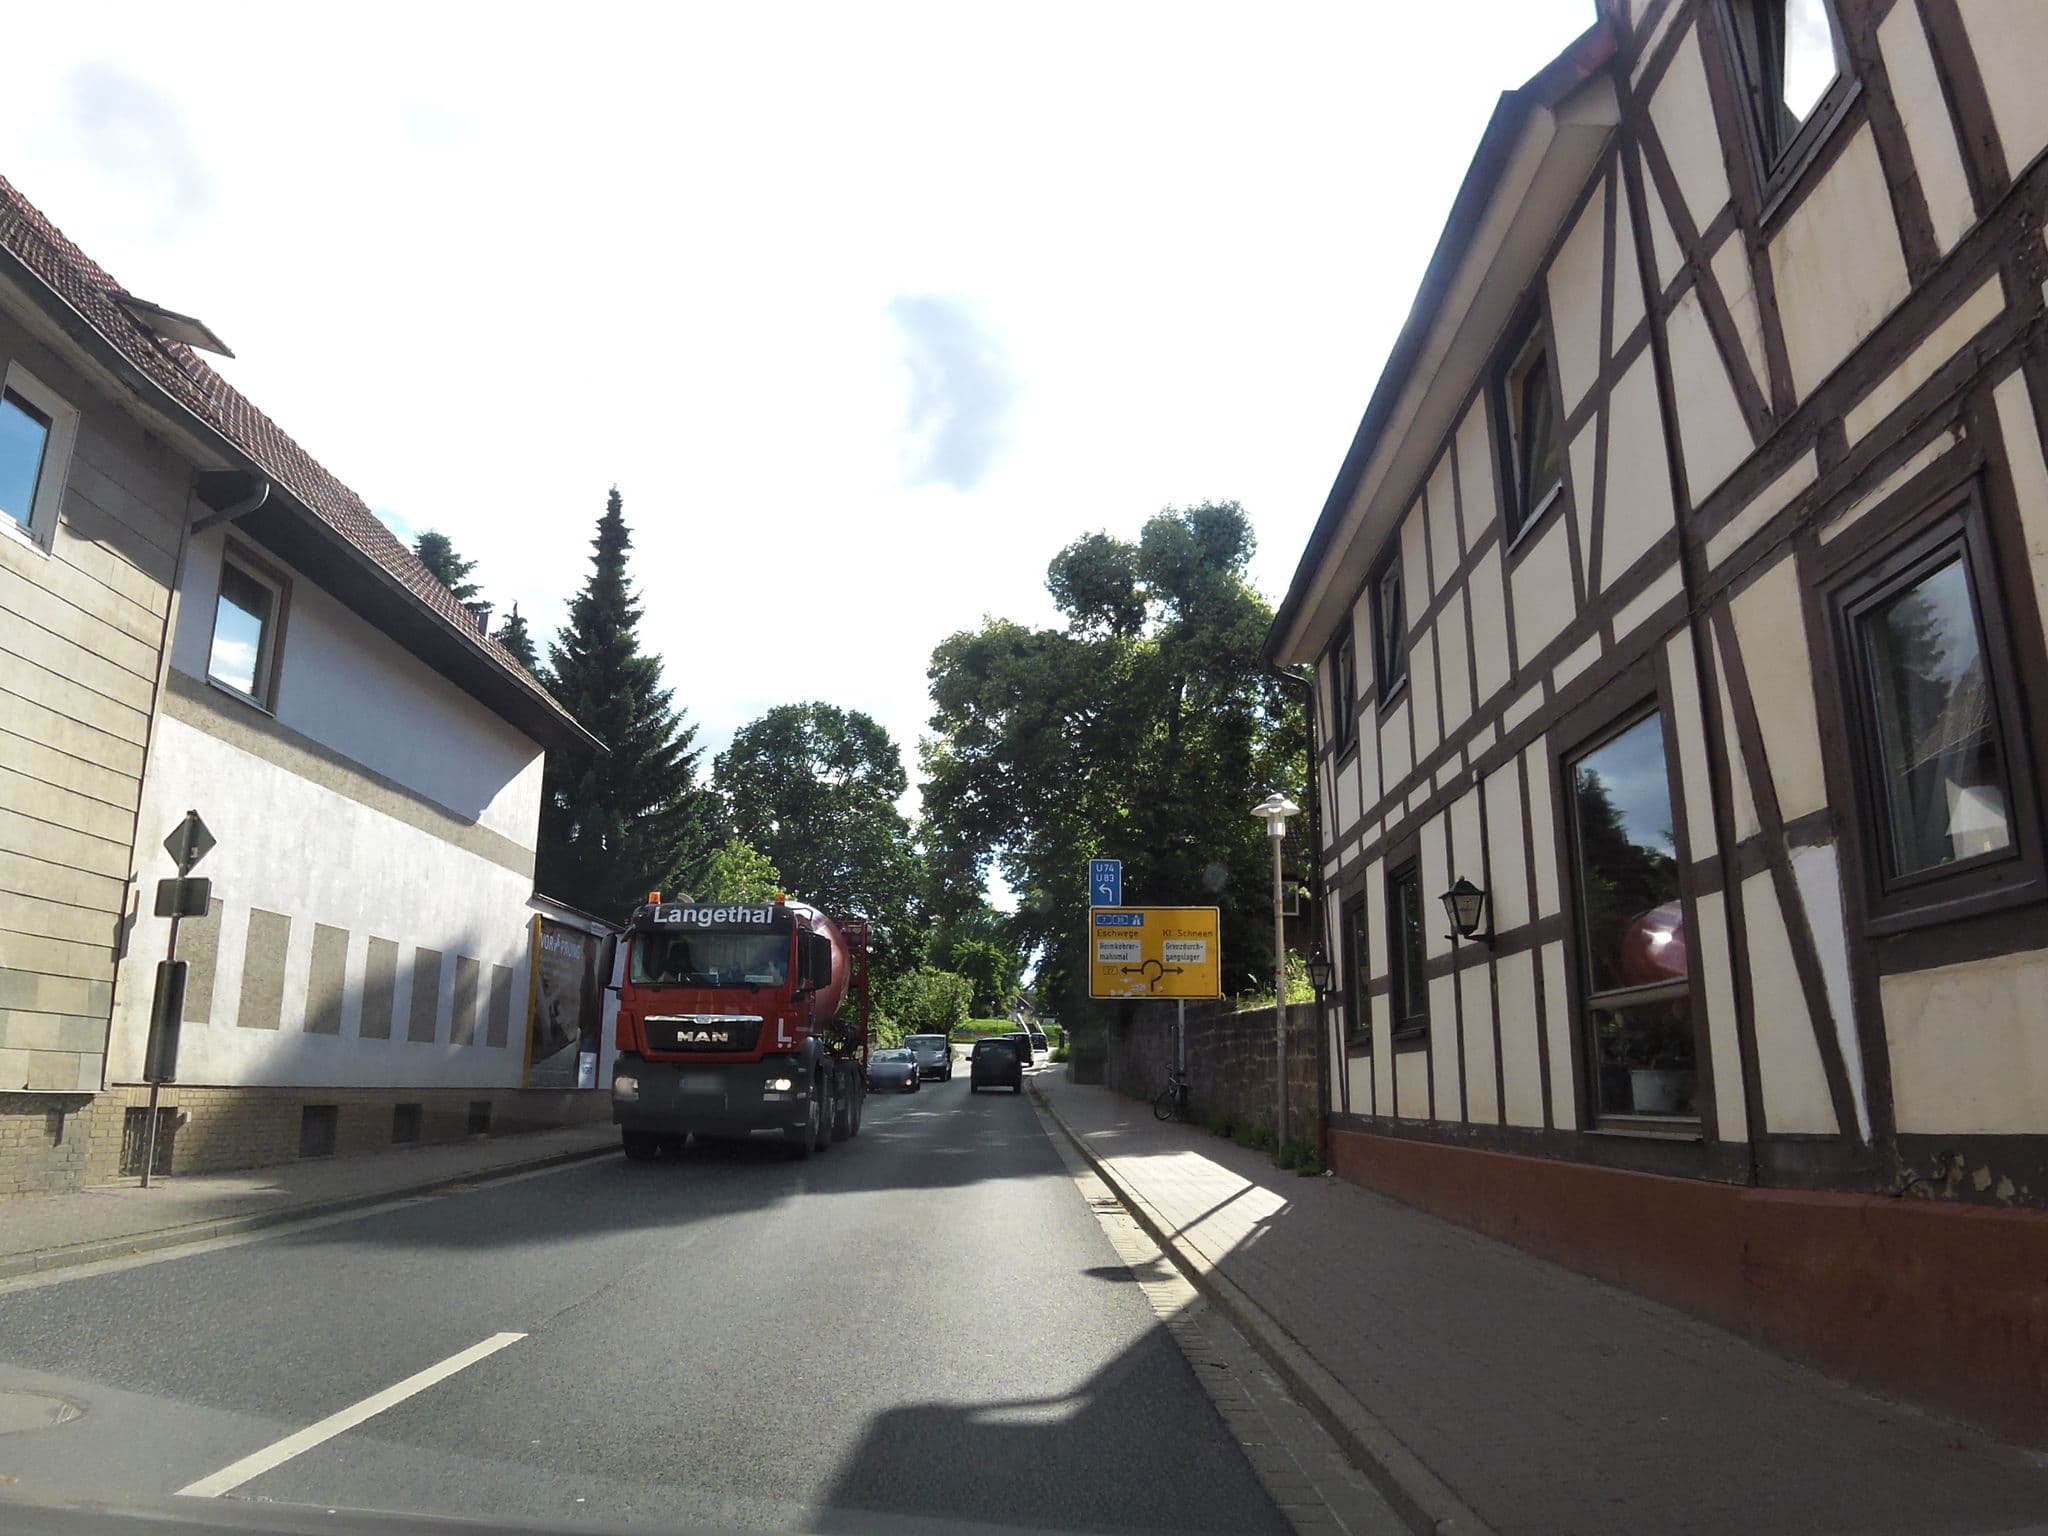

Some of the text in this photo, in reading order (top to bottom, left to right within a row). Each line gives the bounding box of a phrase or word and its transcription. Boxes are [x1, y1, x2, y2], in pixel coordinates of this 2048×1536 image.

[653, 905, 774, 927] Langethal
[1097, 928, 1139, 938] Eschwege
[676, 1031, 729, 1043] MAN
